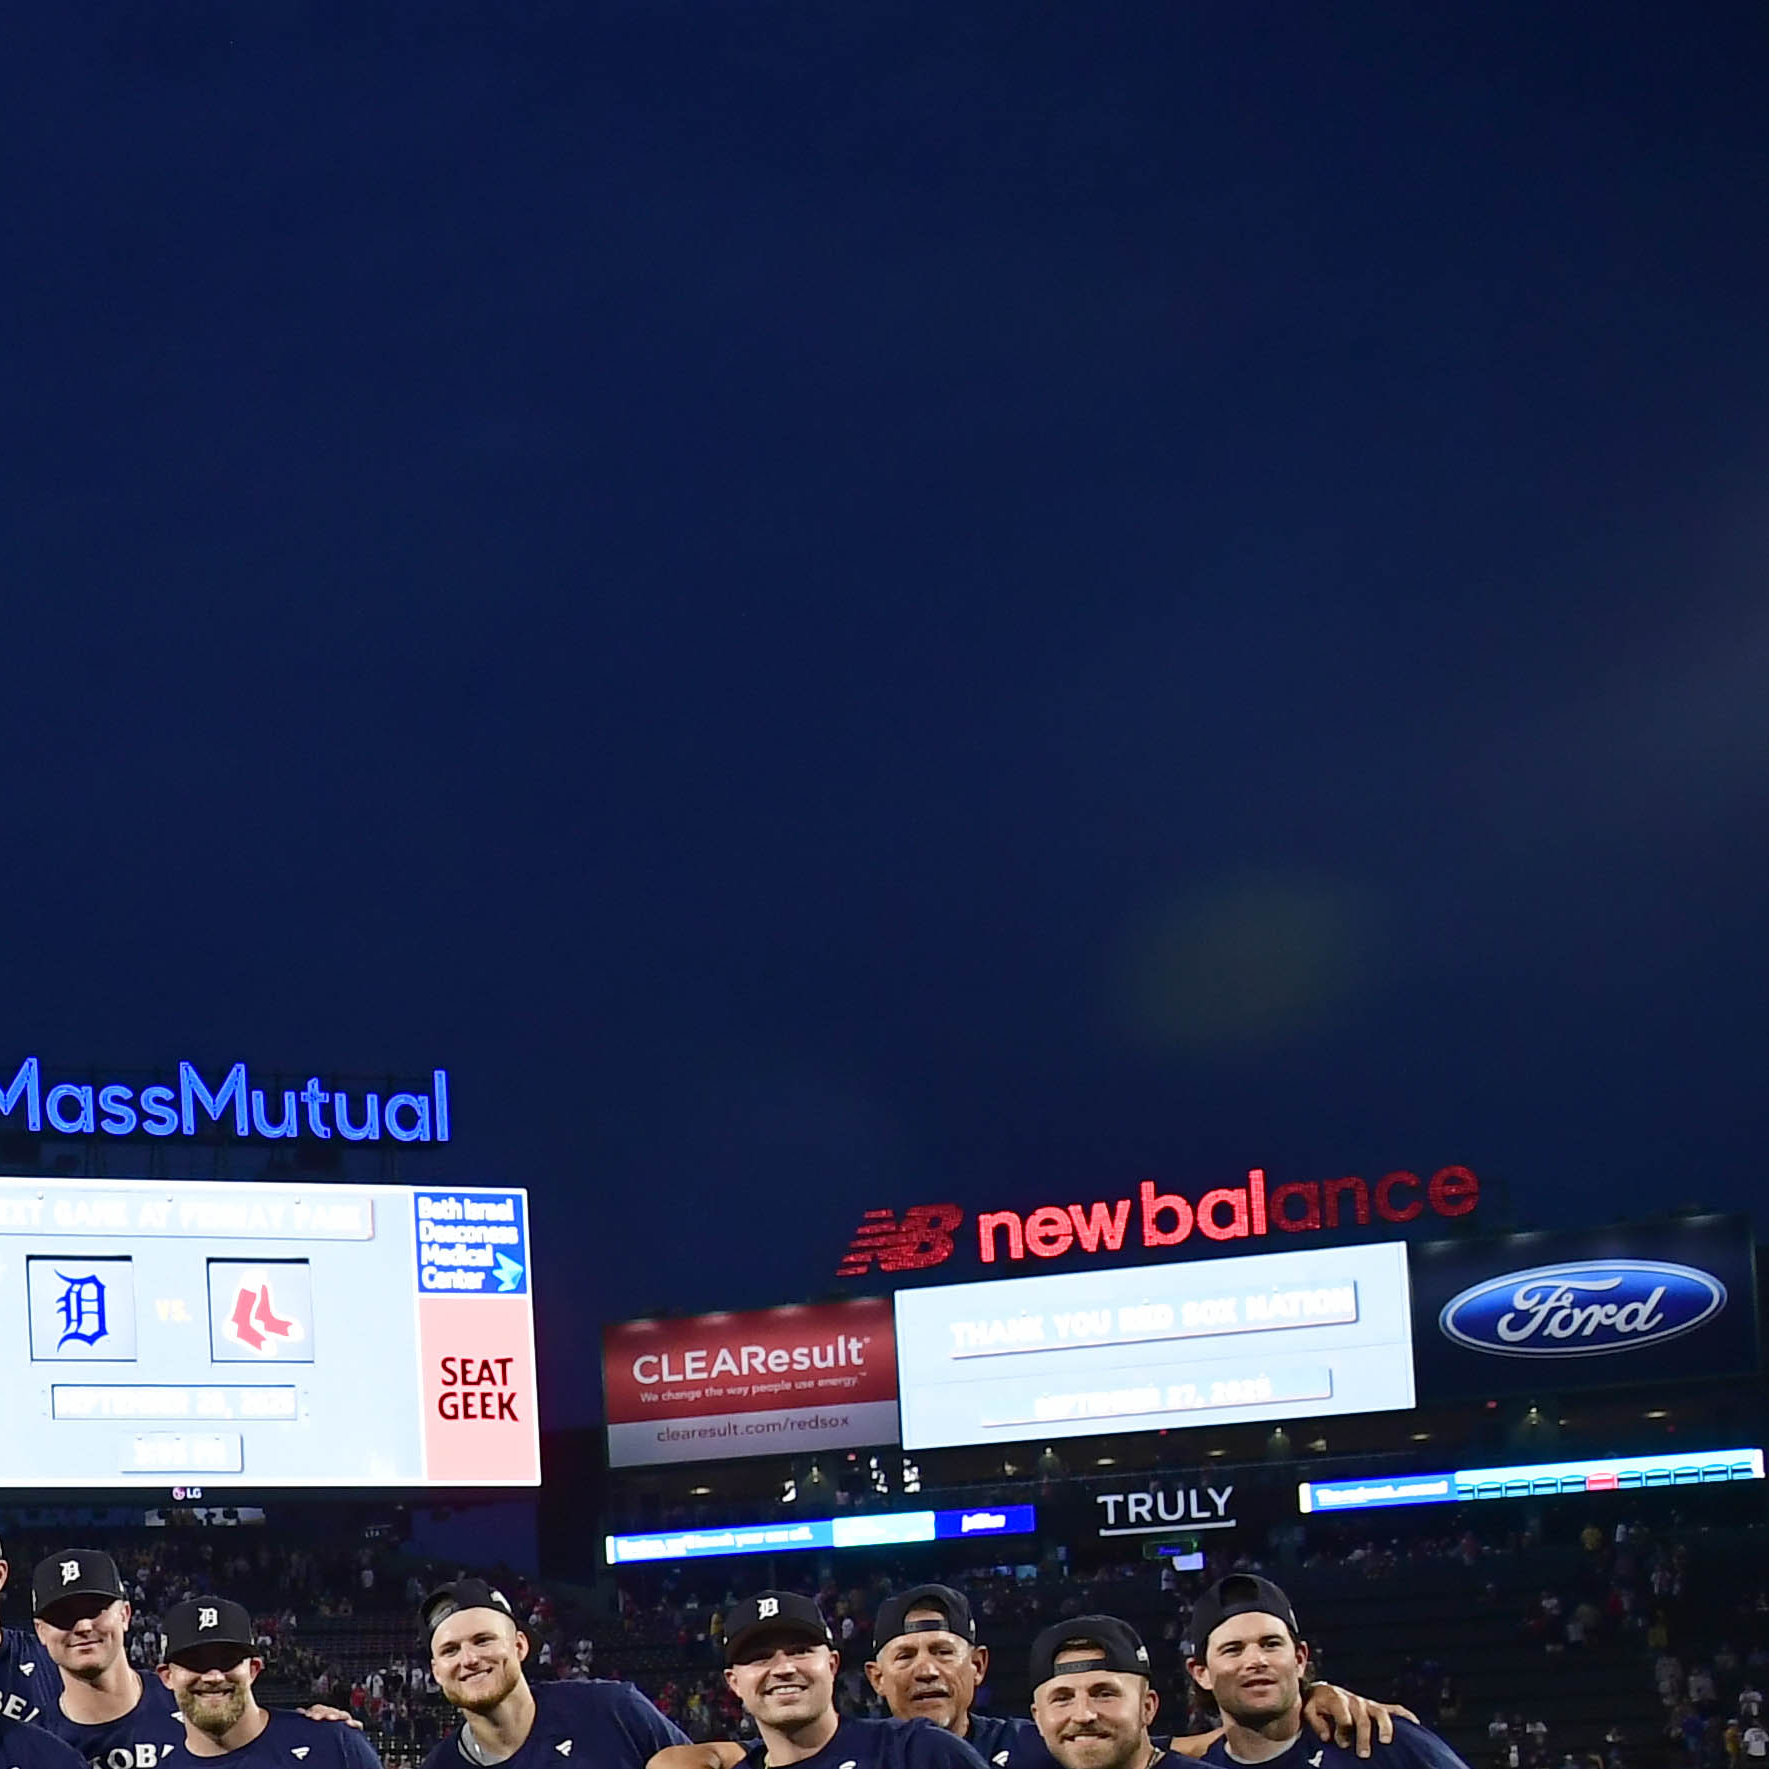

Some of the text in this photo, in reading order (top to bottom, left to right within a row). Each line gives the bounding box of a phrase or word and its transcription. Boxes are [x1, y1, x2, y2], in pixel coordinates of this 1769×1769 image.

[976, 1195, 1132, 1263] new
[1139, 1164, 1483, 1249] balance
[1053, 1308, 1111, 1338] YOU
[1495, 1272, 1669, 1344] Ford
[439, 1356, 514, 1387] SEAT
[632, 1334, 865, 1386] CLEAResult
[437, 1391, 520, 1422] GEEK
[661, 1387, 703, 1403] change
[705, 1385, 724, 1398] the
[726, 1384, 750, 1399] way
[751, 1380, 793, 1397] people
[794, 1380, 815, 1391] use
[656, 1414, 851, 1443] clearesult.com/redsox
[186, 1487, 203, 1499] LG
[1096, 1485, 1235, 1526] TRULY
